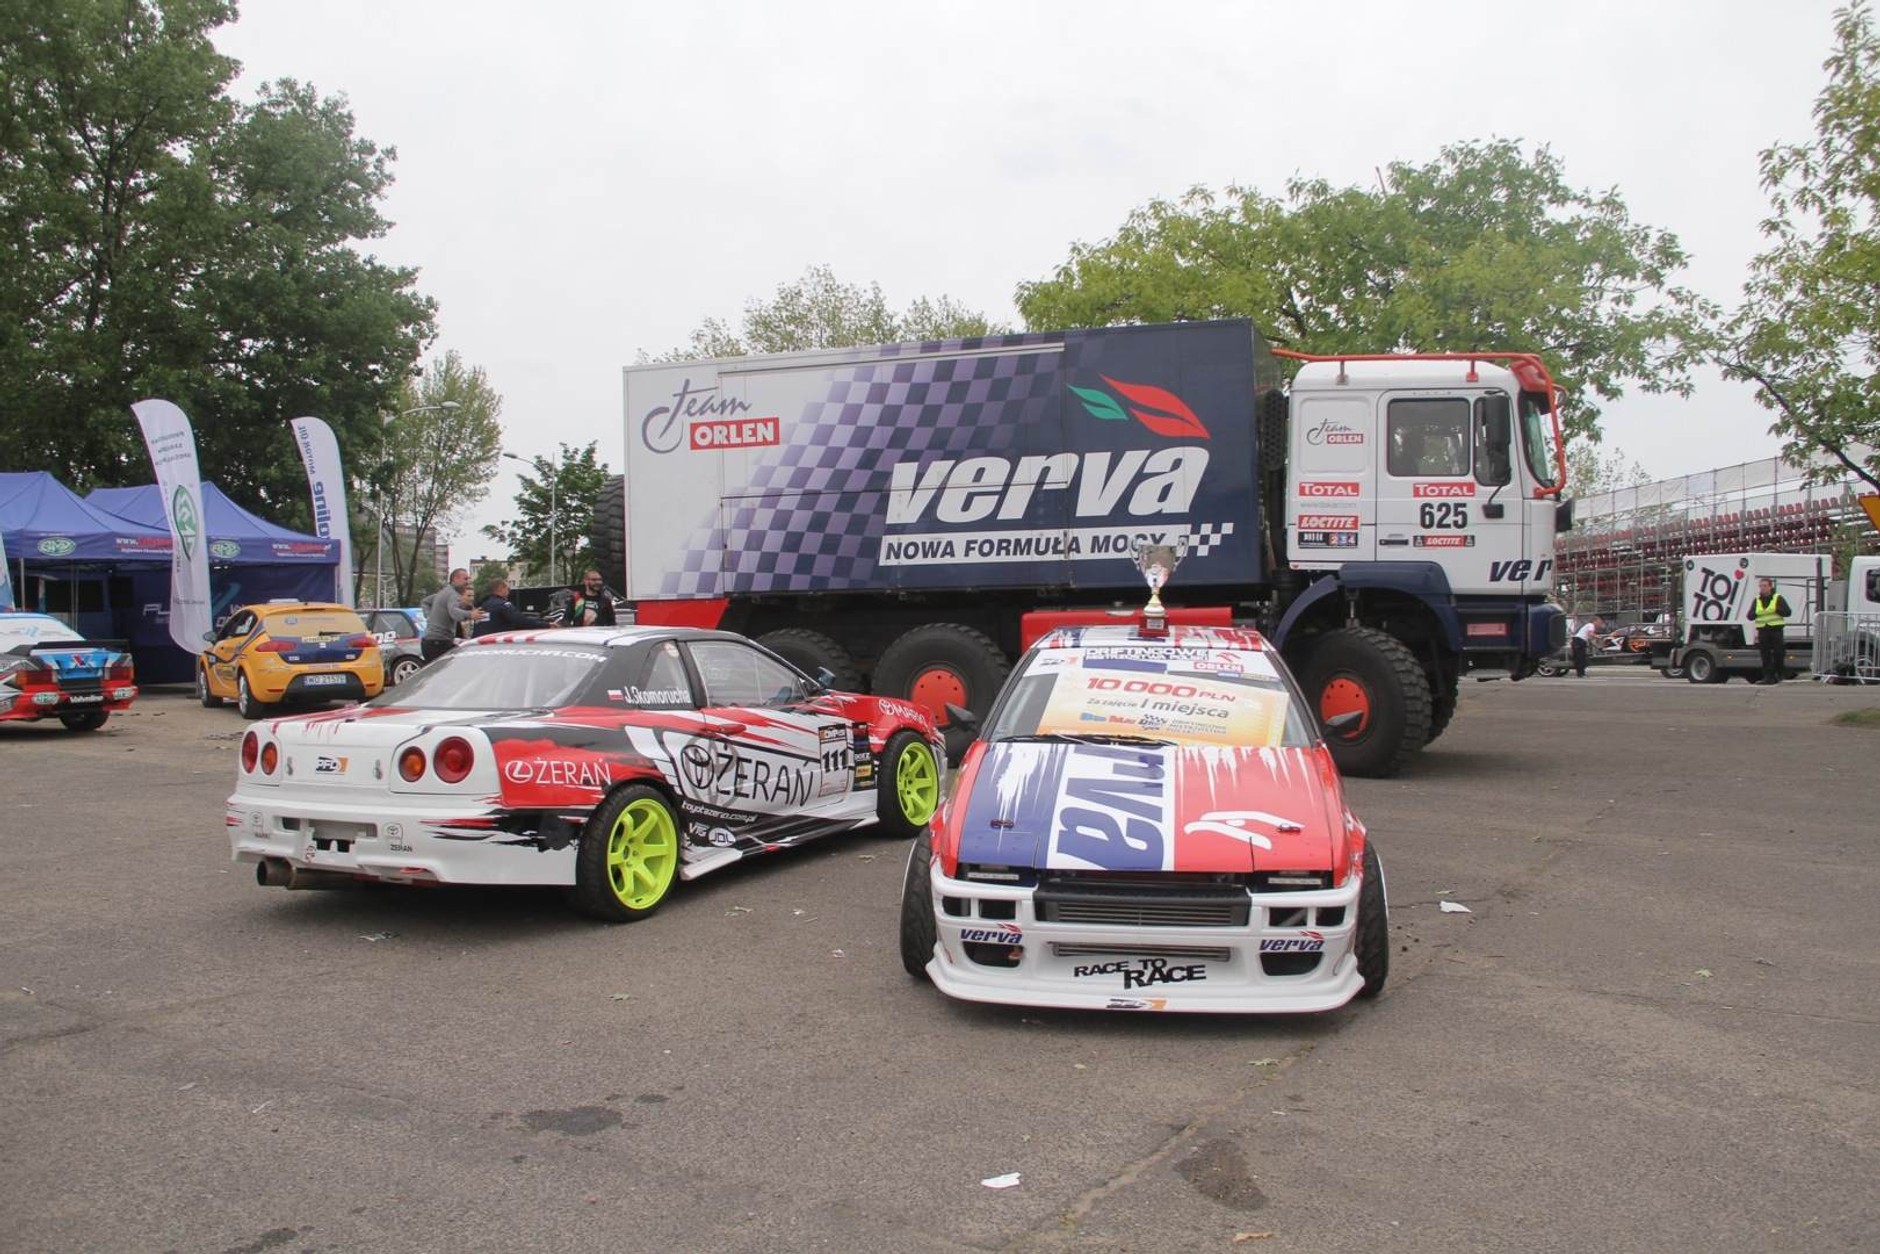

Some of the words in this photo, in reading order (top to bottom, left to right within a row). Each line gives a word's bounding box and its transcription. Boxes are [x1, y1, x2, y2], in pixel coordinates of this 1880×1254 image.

[694, 422, 775, 446] ORLEN
[1329, 434, 1362, 443] ORLEN
[886, 446, 1209, 524] verva
[1301, 483, 1358, 496] TOTAL
[1415, 483, 1474, 496] TOTAL
[1301, 516, 1356, 528] LOCTITE
[1420, 502, 1468, 529] 625
[885, 538, 955, 560] NOWA
[964, 534, 1081, 558] FORMUŁA
[1426, 536, 1462, 546] LOCTITE
[1087, 678, 1122, 690] 10
[1124, 681, 1198, 697] 000
[1199, 691, 1236, 701] PLN
[1152, 701, 1229, 718] miejsca
[822, 749, 848, 773] 111
[960, 928, 1023, 943] verva
[1259, 938, 1324, 951] verva
[1074, 961, 1129, 977] RACE
[1138, 958, 1168, 970] TO
[1124, 965, 1207, 989] RACE
